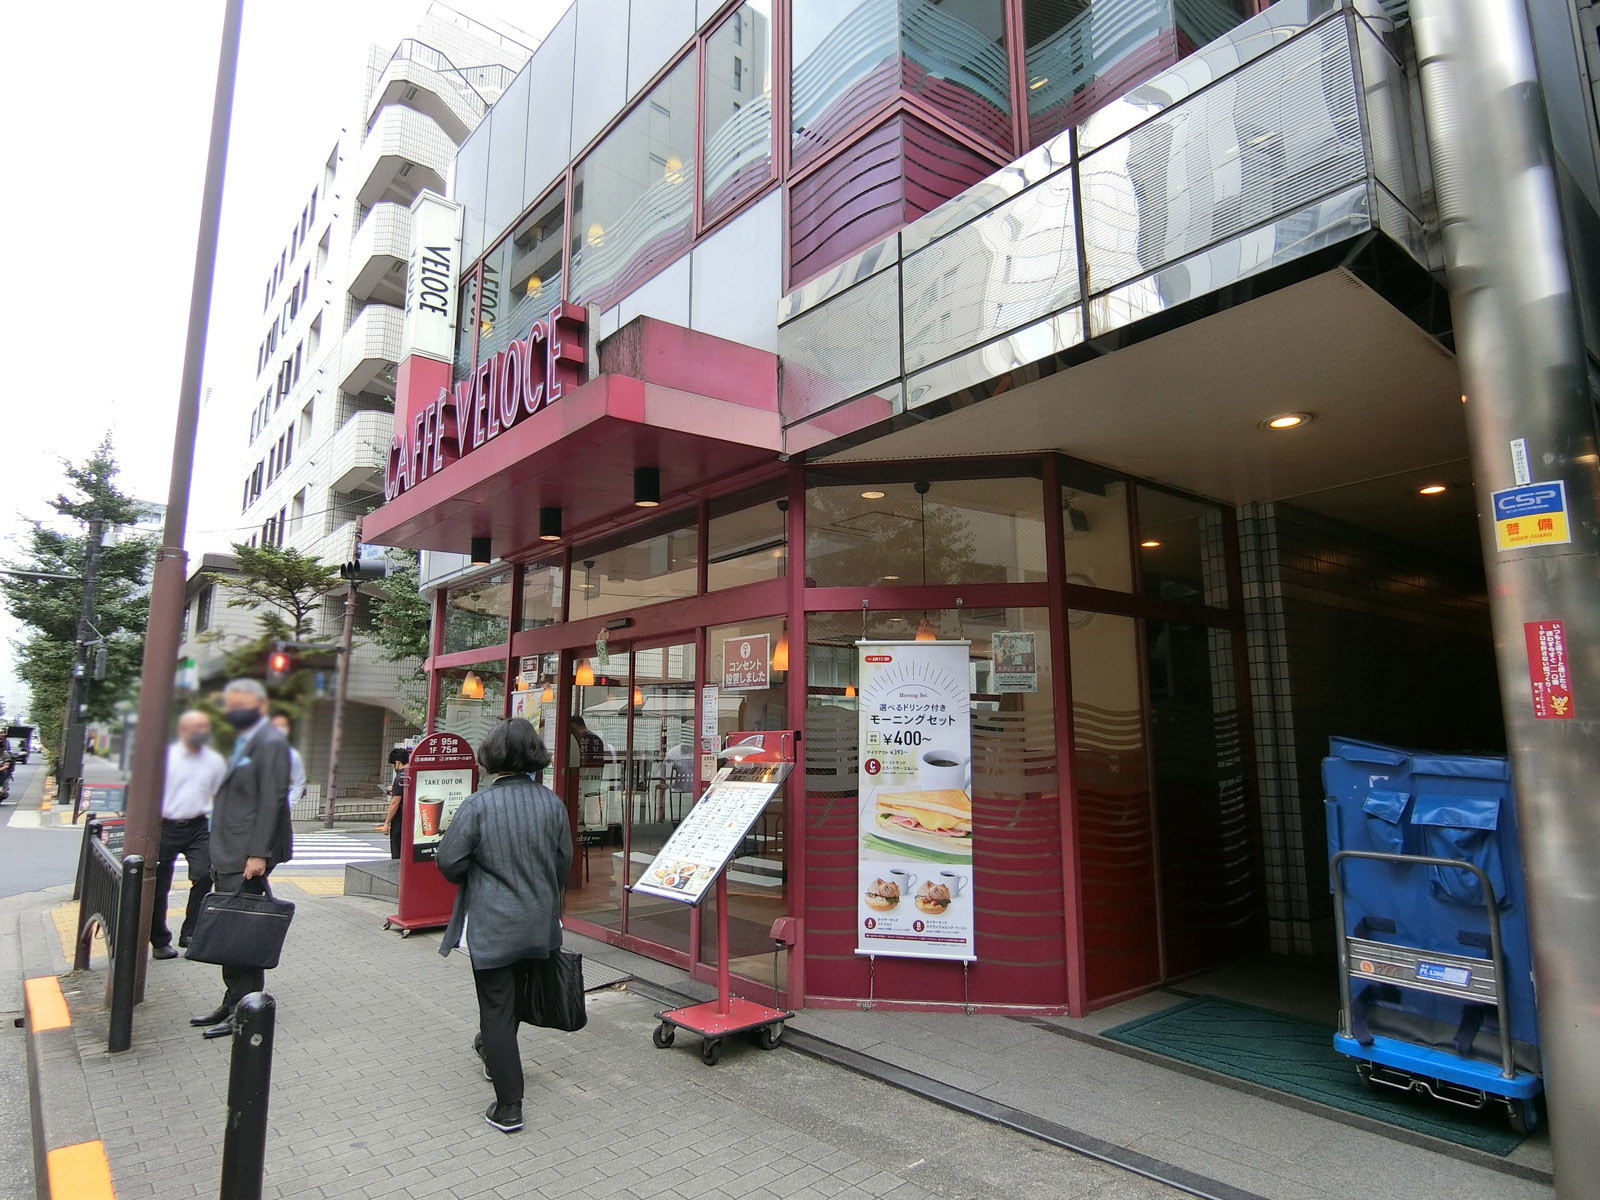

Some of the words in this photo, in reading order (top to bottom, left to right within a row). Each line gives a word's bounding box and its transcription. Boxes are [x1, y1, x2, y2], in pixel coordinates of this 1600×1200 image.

[419, 246, 451, 317] VELOCE
[454, 300, 572, 458] VELOCE
[1498, 490, 1556, 510] CSP
[1506, 518, 1553, 536] 警備
[1509, 535, 1529, 543] UNDER
[1530, 532, 1553, 540] GUARD
[729, 658, 762, 671] コンセント
[725, 671, 766, 685] 設置しました
[879, 703, 947, 712] 選べるドリンク付き
[870, 714, 956, 726] モーニングセット
[429, 738, 438, 746] 2F
[869, 760, 876, 770] C
